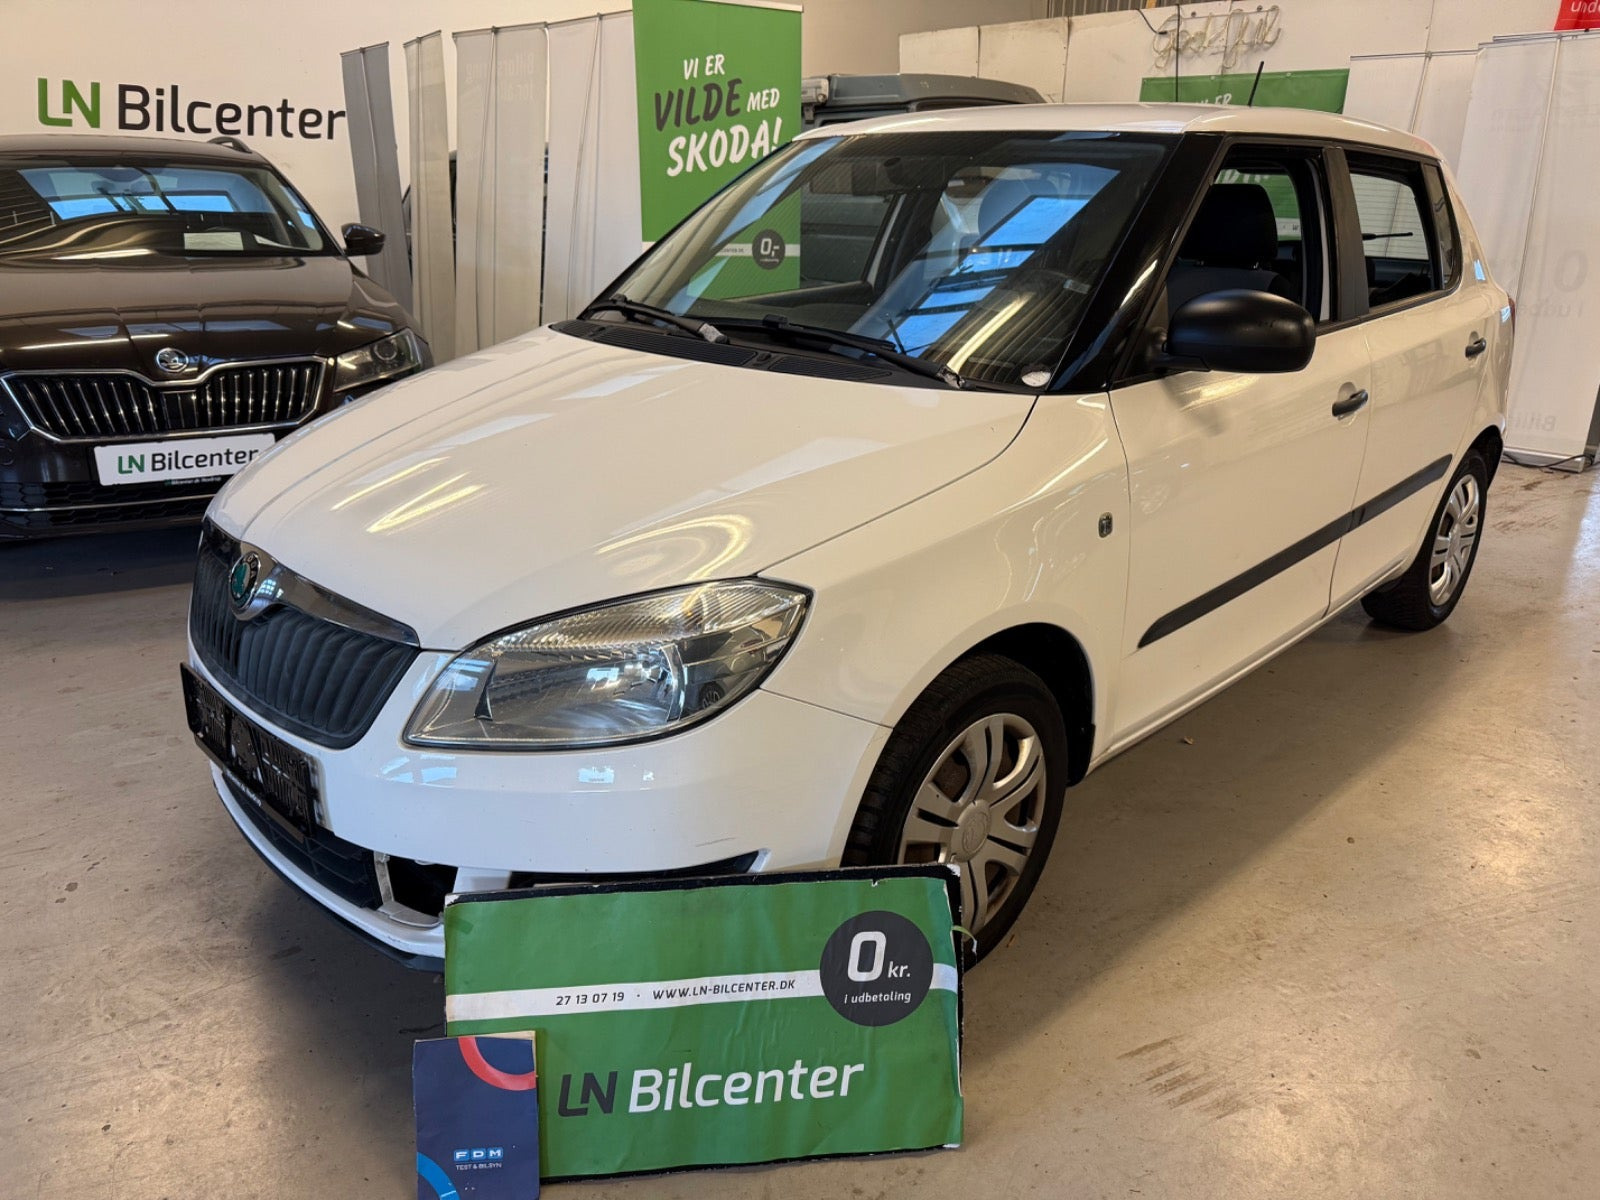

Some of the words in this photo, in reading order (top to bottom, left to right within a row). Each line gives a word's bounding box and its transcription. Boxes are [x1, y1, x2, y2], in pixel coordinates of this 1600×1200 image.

[1571, 0, 1600, 13] und
[684, 58, 699, 80] VI
[705, 54, 725, 76] ER
[37, 77, 100, 129] LN
[118, 83, 346, 140] Bilcenter
[654, 78, 742, 132] VILDE
[747, 88, 780, 112] MED
[667, 116, 782, 177] SKODA!
[118, 454, 145, 474] LN
[151, 448, 259, 472] Bilcenter
[847, 931, 887, 982] 0
[887, 961, 911, 978] kr.
[556, 996, 571, 1006] 27
[576, 994, 587, 1005] 13
[592, 993, 607, 1003] 07
[612, 991, 625, 1002] 19
[652, 979, 796, 1000] WWW.LN-BILCENTER.DK
[844, 994, 848, 1004] i
[851, 991, 911, 1004] udbetaling
[557, 1071, 618, 1118] LN
[628, 1059, 865, 1113] Bilcenter
[455, 1149, 502, 1160] FDM
[478, 1162, 502, 1170] BILSYN
